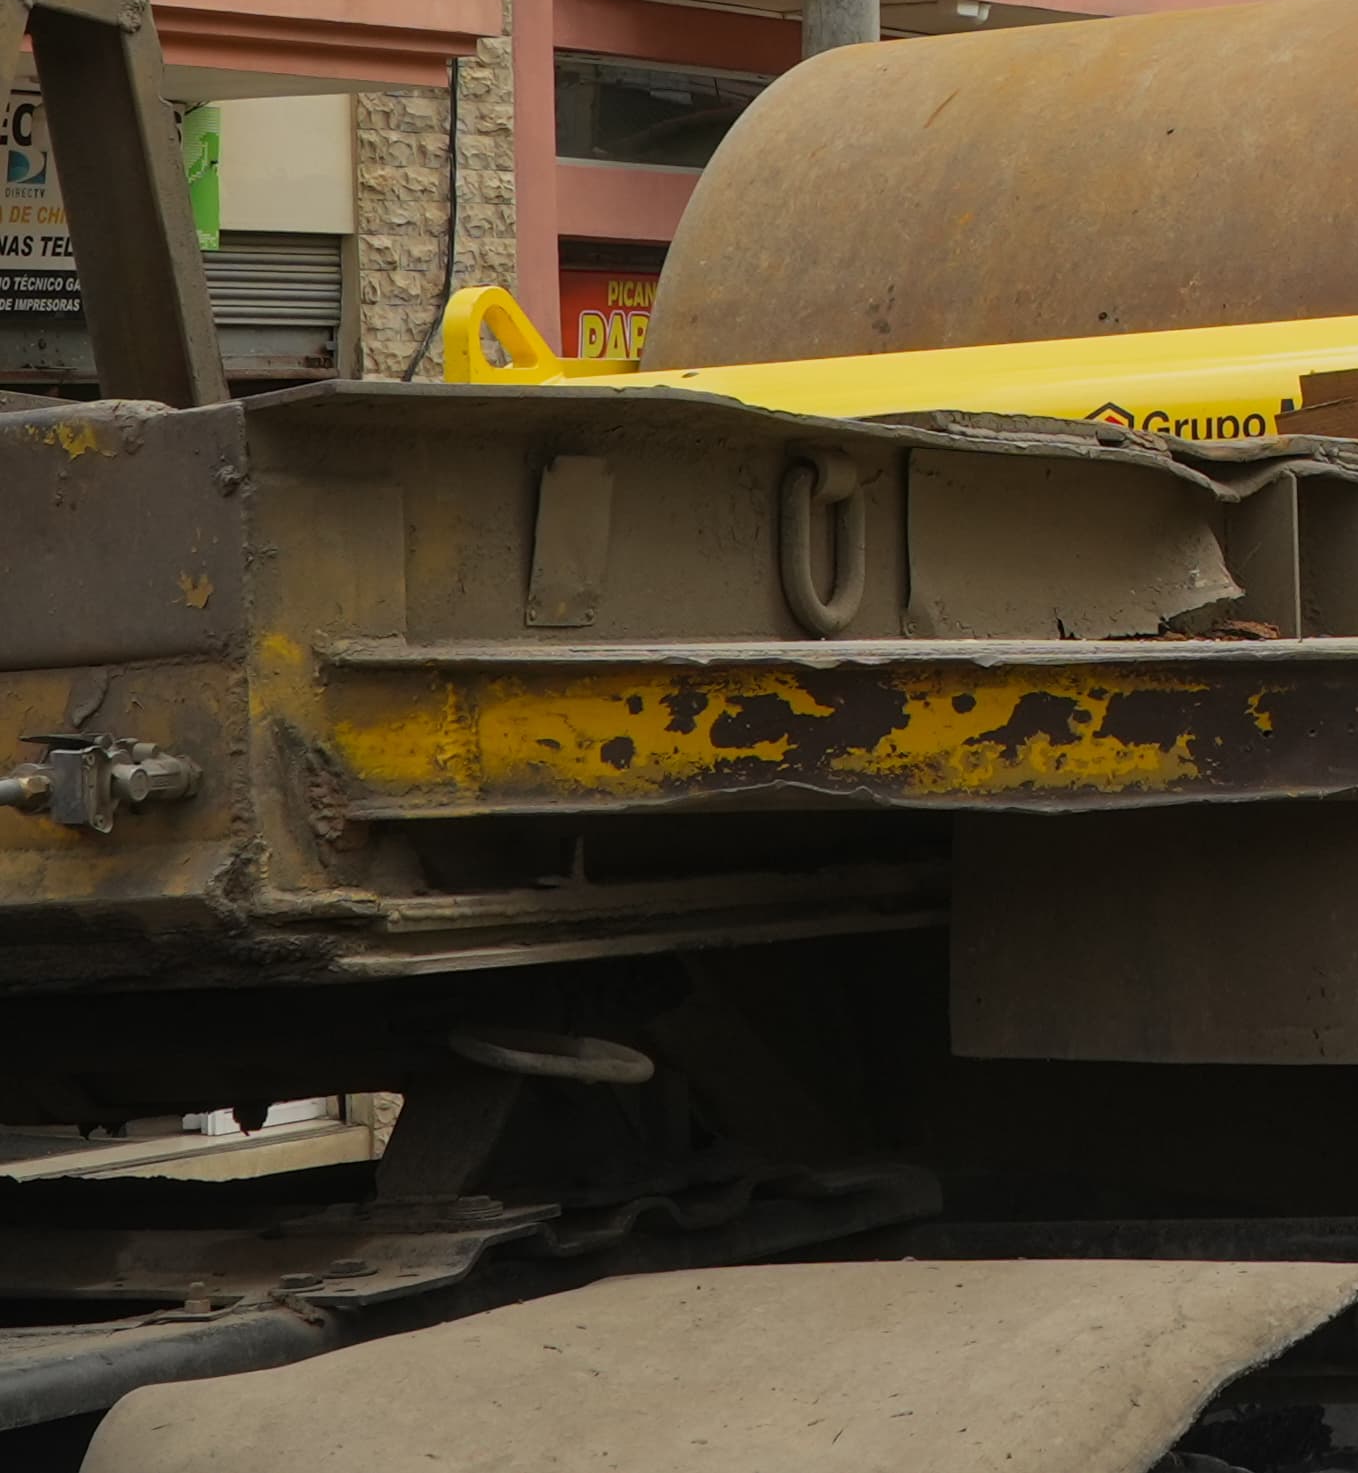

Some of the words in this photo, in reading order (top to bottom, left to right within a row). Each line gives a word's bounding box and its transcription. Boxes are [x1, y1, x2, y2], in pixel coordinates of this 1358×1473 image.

[5, 187, 46, 199] DIRECTV
[8, 205, 33, 225] DE
[40, 236, 74, 257] TEL
[14, 273, 63, 291] TÉCNICO
[65, 277, 81, 292] GA
[607, 280, 657, 307] PICAN
[14, 298, 81, 311] IMPRESORAS
[578, 310, 650, 358] DAP
[1141, 410, 1267, 440] Grupo
